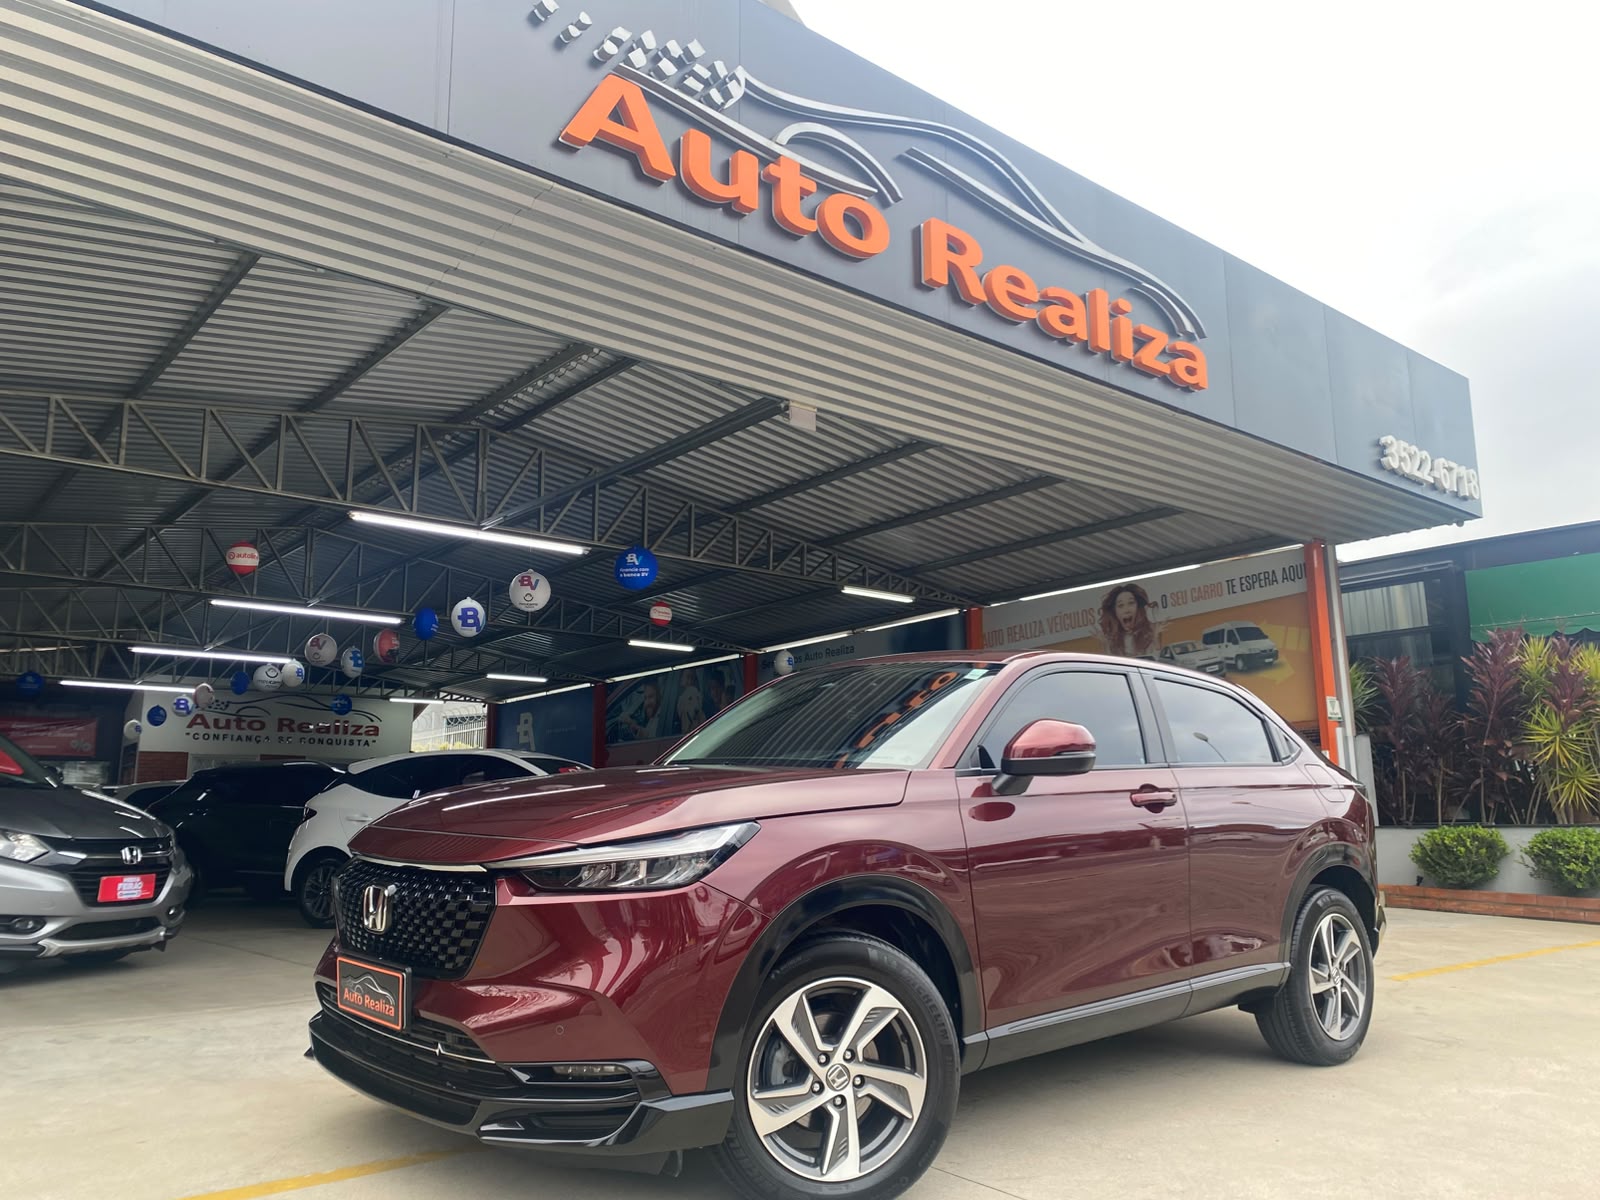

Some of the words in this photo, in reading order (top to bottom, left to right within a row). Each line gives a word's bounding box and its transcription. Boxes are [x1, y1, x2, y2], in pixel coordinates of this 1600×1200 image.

[558, 73, 891, 261] Auto
[919, 216, 1209, 392] Realiza
[518, 575, 540, 591] BV
[1160, 594, 1168, 609] O
[1169, 590, 1189, 607] SEU
[1190, 582, 1225, 603] CARRO
[1225, 578, 1237, 595] TE
[1239, 569, 1279, 593] ESPERA
[983, 628, 1005, 648] AUTO
[1007, 620, 1046, 643] REALIZA
[1046, 607, 1096, 634] VEÍCULOS
[804, 651, 824, 662] Auto
[825, 644, 855, 658] Realiza
[186, 713, 266, 732] Auto
[277, 717, 380, 737] Realiza
[343, 987, 363, 1006] Auto
[364, 994, 395, 1018] Realiza
